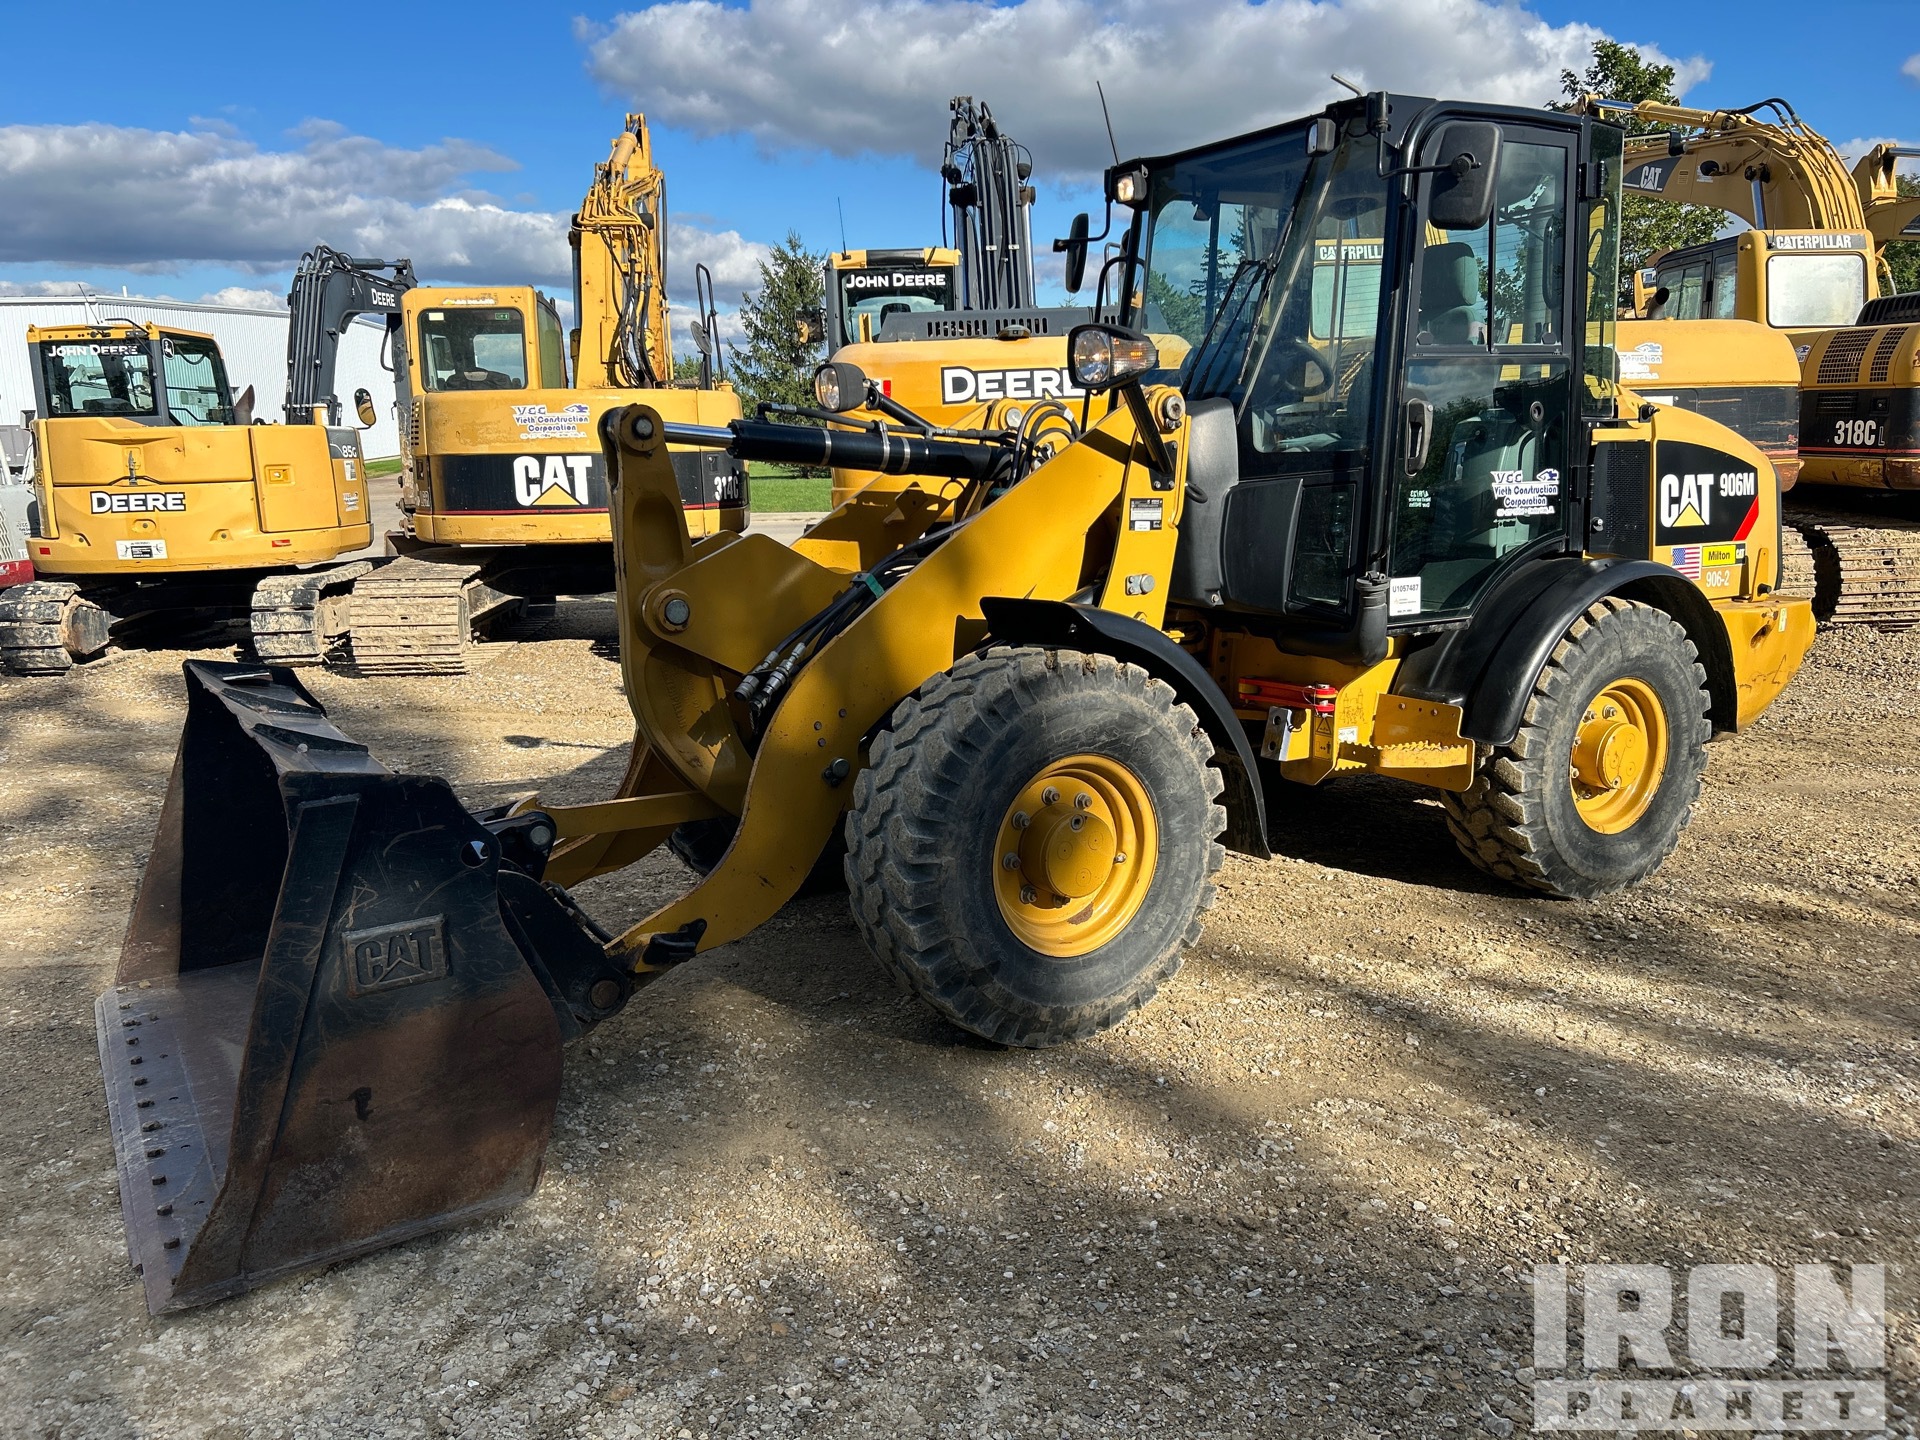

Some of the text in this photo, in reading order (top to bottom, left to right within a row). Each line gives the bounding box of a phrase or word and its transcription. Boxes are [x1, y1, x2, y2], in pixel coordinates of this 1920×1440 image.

[1640, 165, 1662, 190] CAT
[1776, 235, 1852, 249] CATERPILLAR
[1319, 245, 1384, 260] CAERPILL
[846, 273, 946, 288] JOHN DEERE
[371, 287, 396, 307] DEERE
[48, 344, 138, 357] JOHN DEERE
[515, 416, 589, 424] Vieth Construction
[528, 424, 577, 432] Corporation
[1834, 420, 1877, 446] 318C
[342, 445, 357, 458] 85G
[513, 455, 593, 506] CAT
[714, 475, 739, 501] 314C
[1494, 485, 1557, 496] Vieth Construction
[91, 492, 185, 513] DEERE
[1504, 496, 1546, 507] Corporation
[1660, 473, 1755, 528] CAT 906M
[1708, 550, 1731, 561] Milton
[1706, 570, 1730, 588] 906-2
[355, 929, 436, 986] CAT
